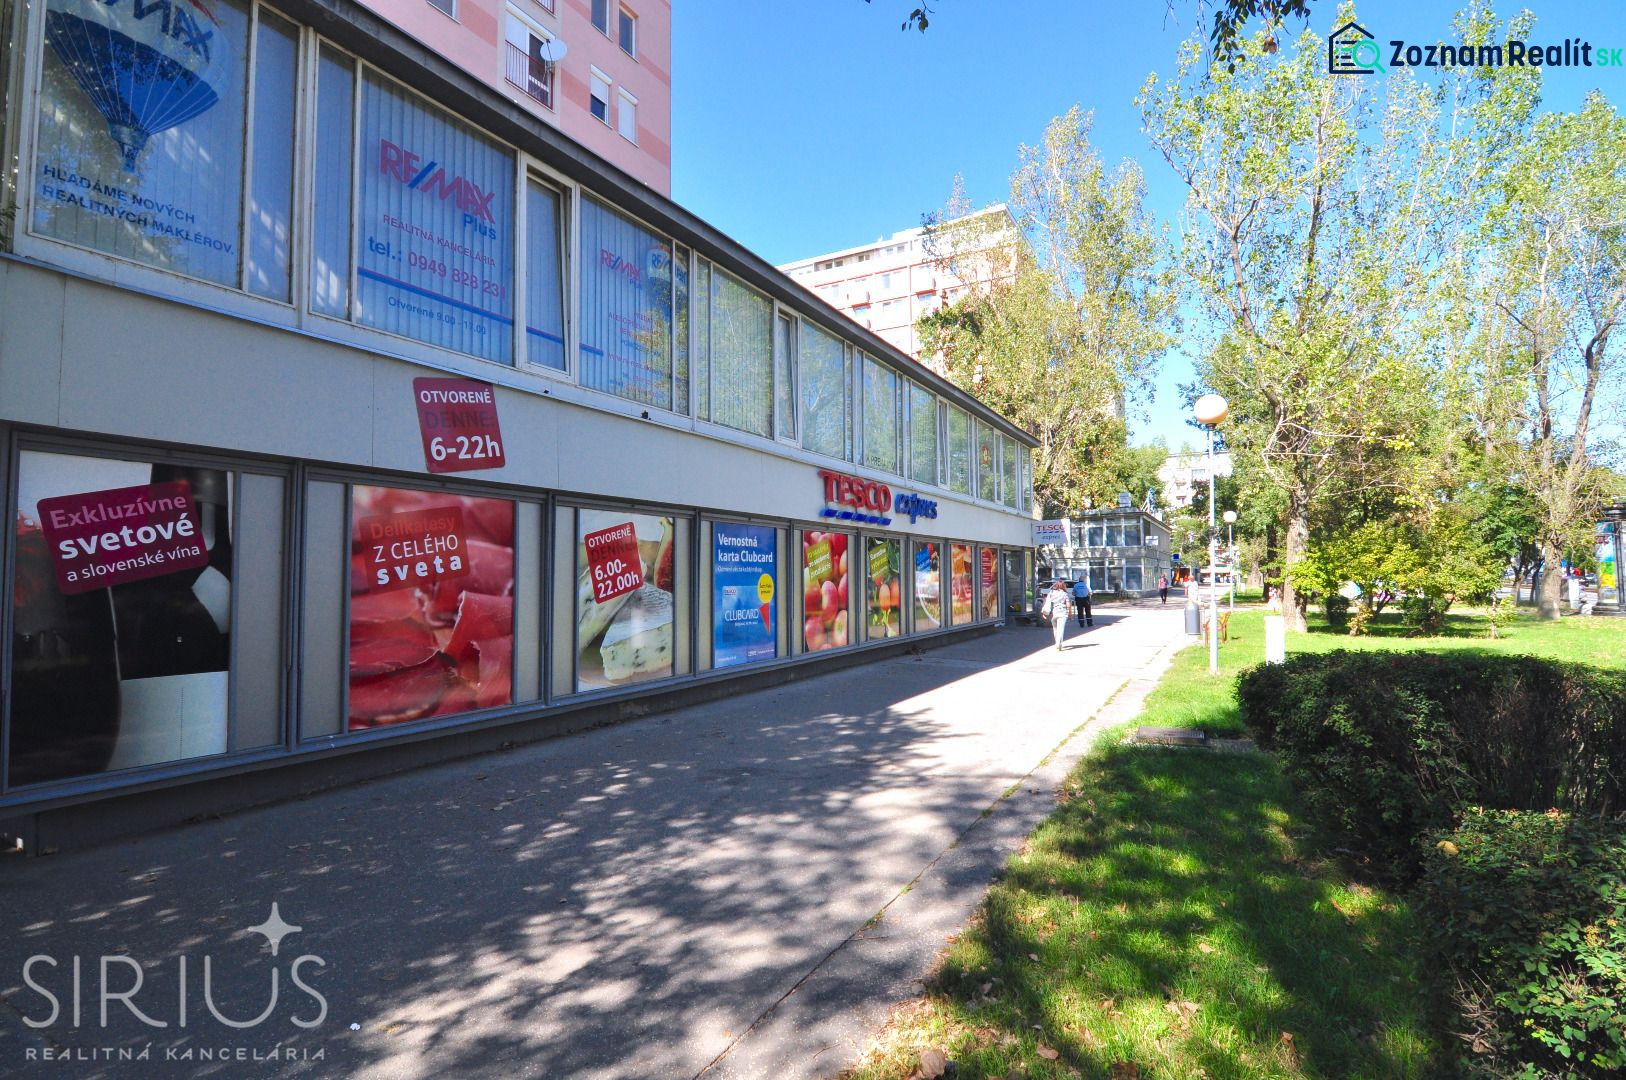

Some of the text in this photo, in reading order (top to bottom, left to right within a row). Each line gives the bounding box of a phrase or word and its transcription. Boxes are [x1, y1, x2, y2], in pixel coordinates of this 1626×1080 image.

[380, 138, 496, 225] RE/MAX
[42, 184, 148, 228] REALITNÝCH
[131, 193, 195, 225] NOVÝCH
[463, 211, 497, 241] Plus
[407, 251, 447, 278] 0949
[451, 267, 479, 289] 828
[388, 296, 434, 319] Otvorené
[420, 388, 492, 404] OTVORENÉ
[430, 434, 501, 461] 6-22h
[818, 469, 892, 513] TESCO
[50, 495, 188, 529] Exkluzívne
[59, 512, 195, 560] svetové
[369, 516, 455, 539] Delikatesy
[717, 533, 758, 547] Vernostná
[1035, 524, 1065, 532] TESCO
[373, 533, 458, 563] Z CELÉHO
[718, 549, 773, 563] karta Clubcard
[66, 545, 201, 582] a slovenské vína
[377, 555, 462, 585] sveta
[594, 558, 627, 580] 6.00-
[597, 571, 640, 598] 22.00h
[724, 608, 760, 621] CLUBCARD
